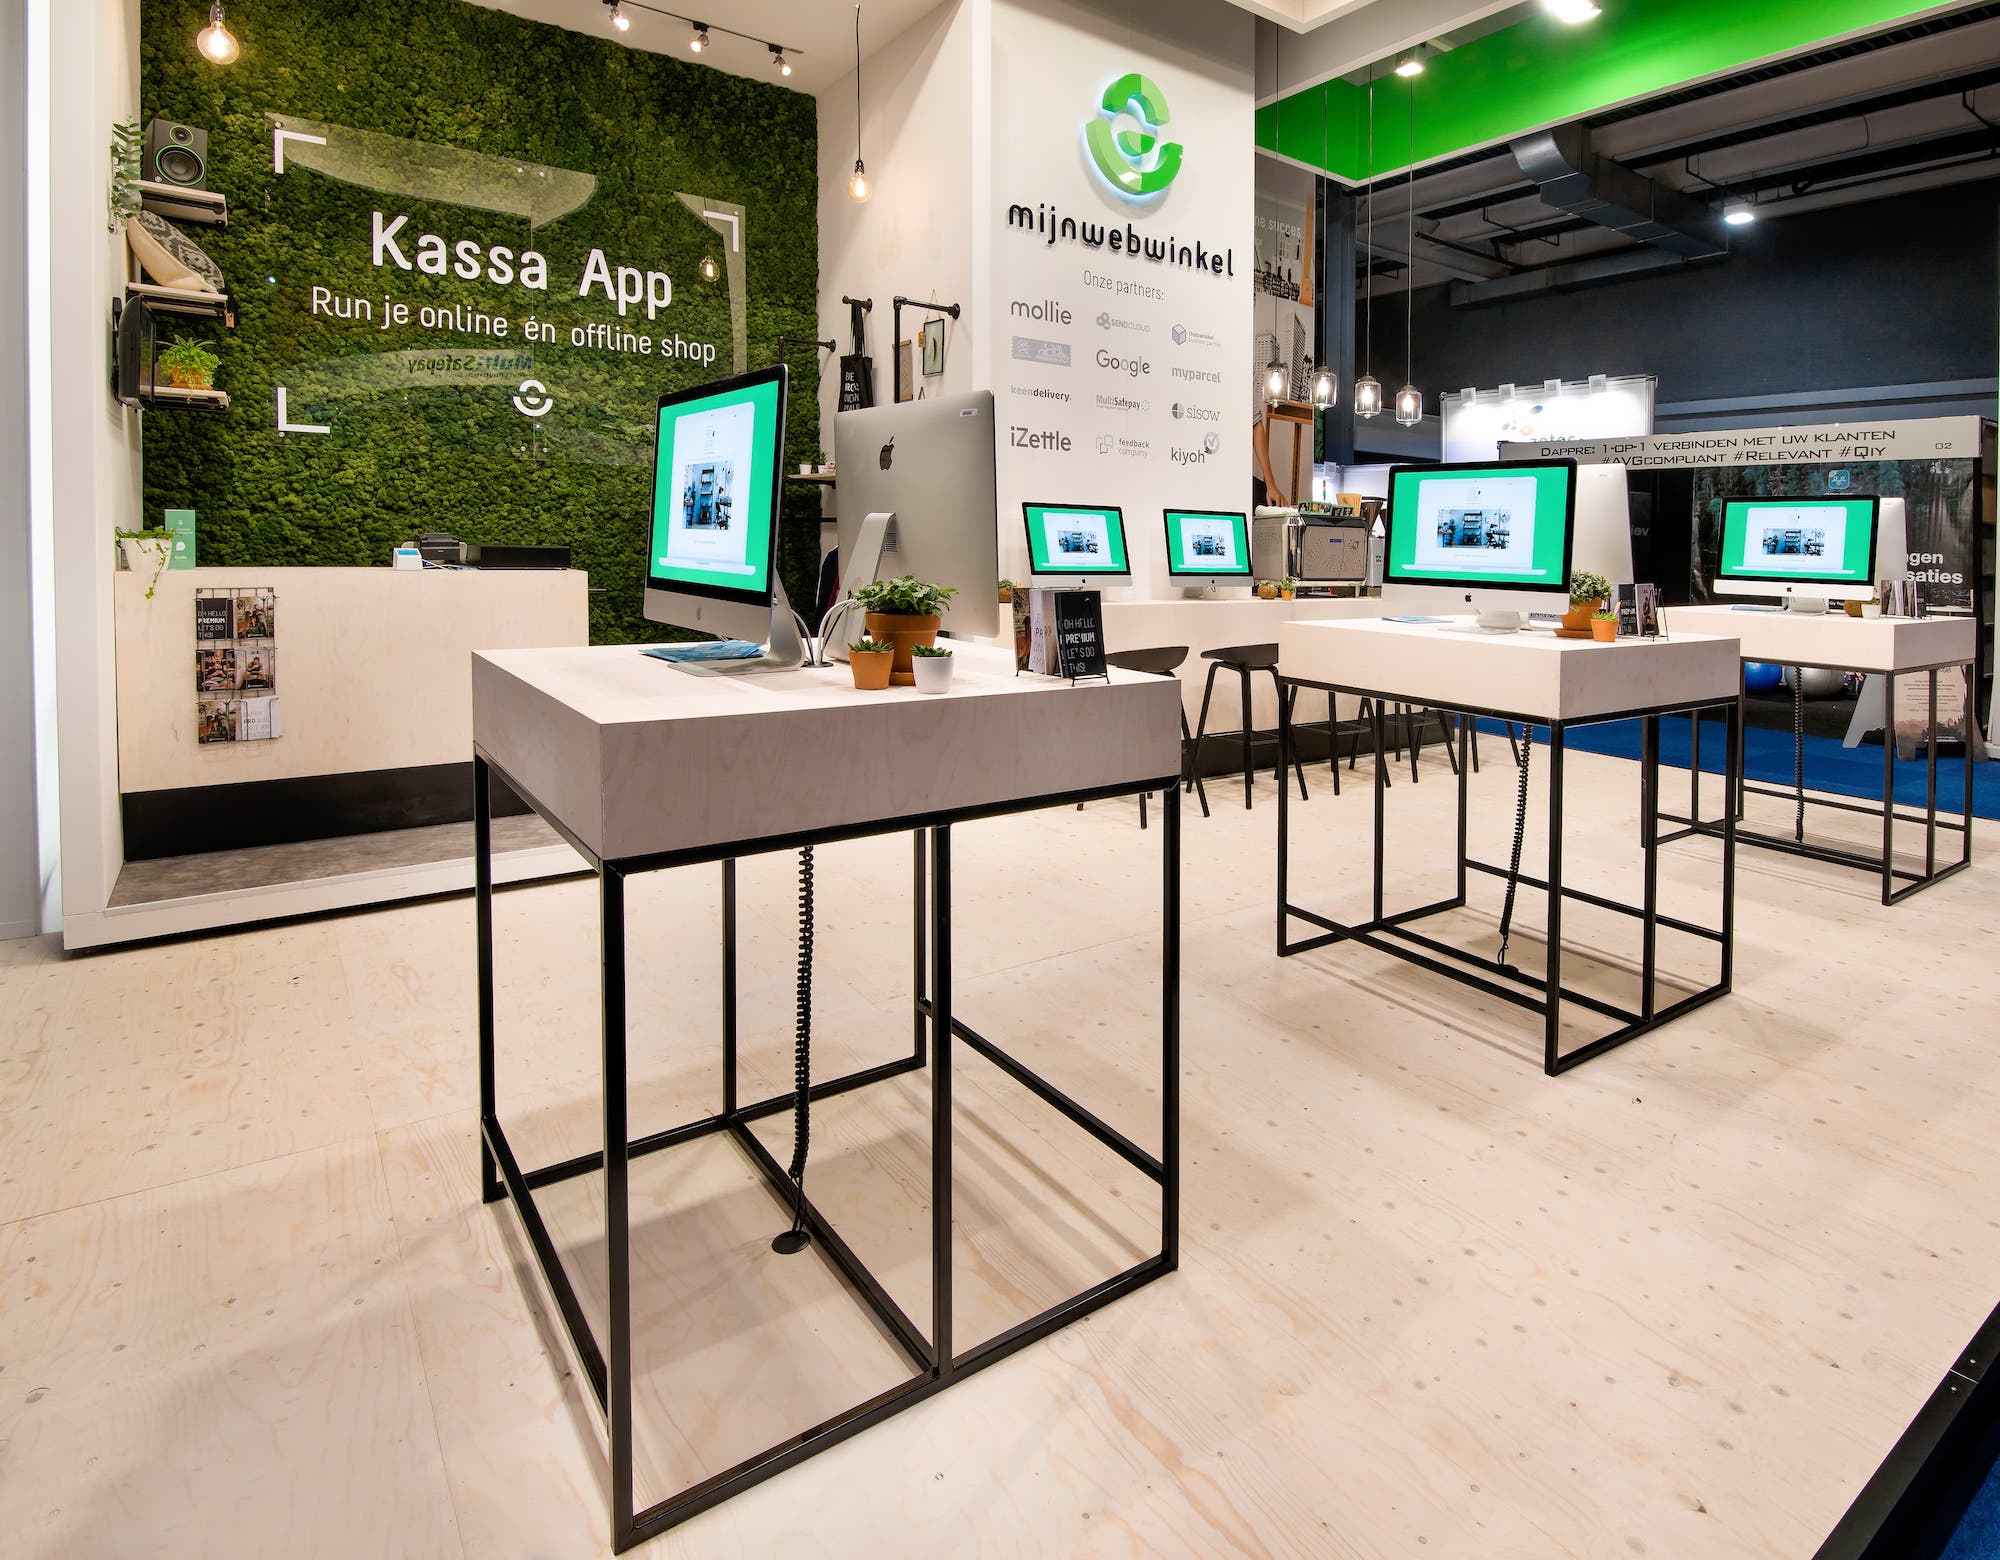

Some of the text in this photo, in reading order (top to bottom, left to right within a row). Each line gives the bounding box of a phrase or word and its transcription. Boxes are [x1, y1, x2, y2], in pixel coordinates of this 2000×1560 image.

[1008, 203, 1234, 277] mijnwebwinkel
[371, 210, 672, 321] Kassa App
[1083, 270, 1164, 301] Onze partners:
[1011, 299, 1072, 325] mollie
[311, 285, 716, 368] Run je online én offline shop
[1096, 349, 1150, 378] Google
[1171, 367, 1221, 383] myparcel
[1095, 394, 1141, 412] MultiSafepay
[1010, 425, 1072, 451] iZettle
[1118, 437, 1150, 449] feedback
[1653, 438, 1738, 452] VERBINDEN
[1743, 436, 1777, 446] MET
[1782, 434, 1809, 445] UW
[1814, 430, 1896, 443] KLANTEN
[1118, 447, 1148, 459] company
[1171, 446, 1205, 466] kiyoh
[1733, 449, 1832, 462] #RELEVANT
[1065, 631, 1095, 645] PREMIUM
